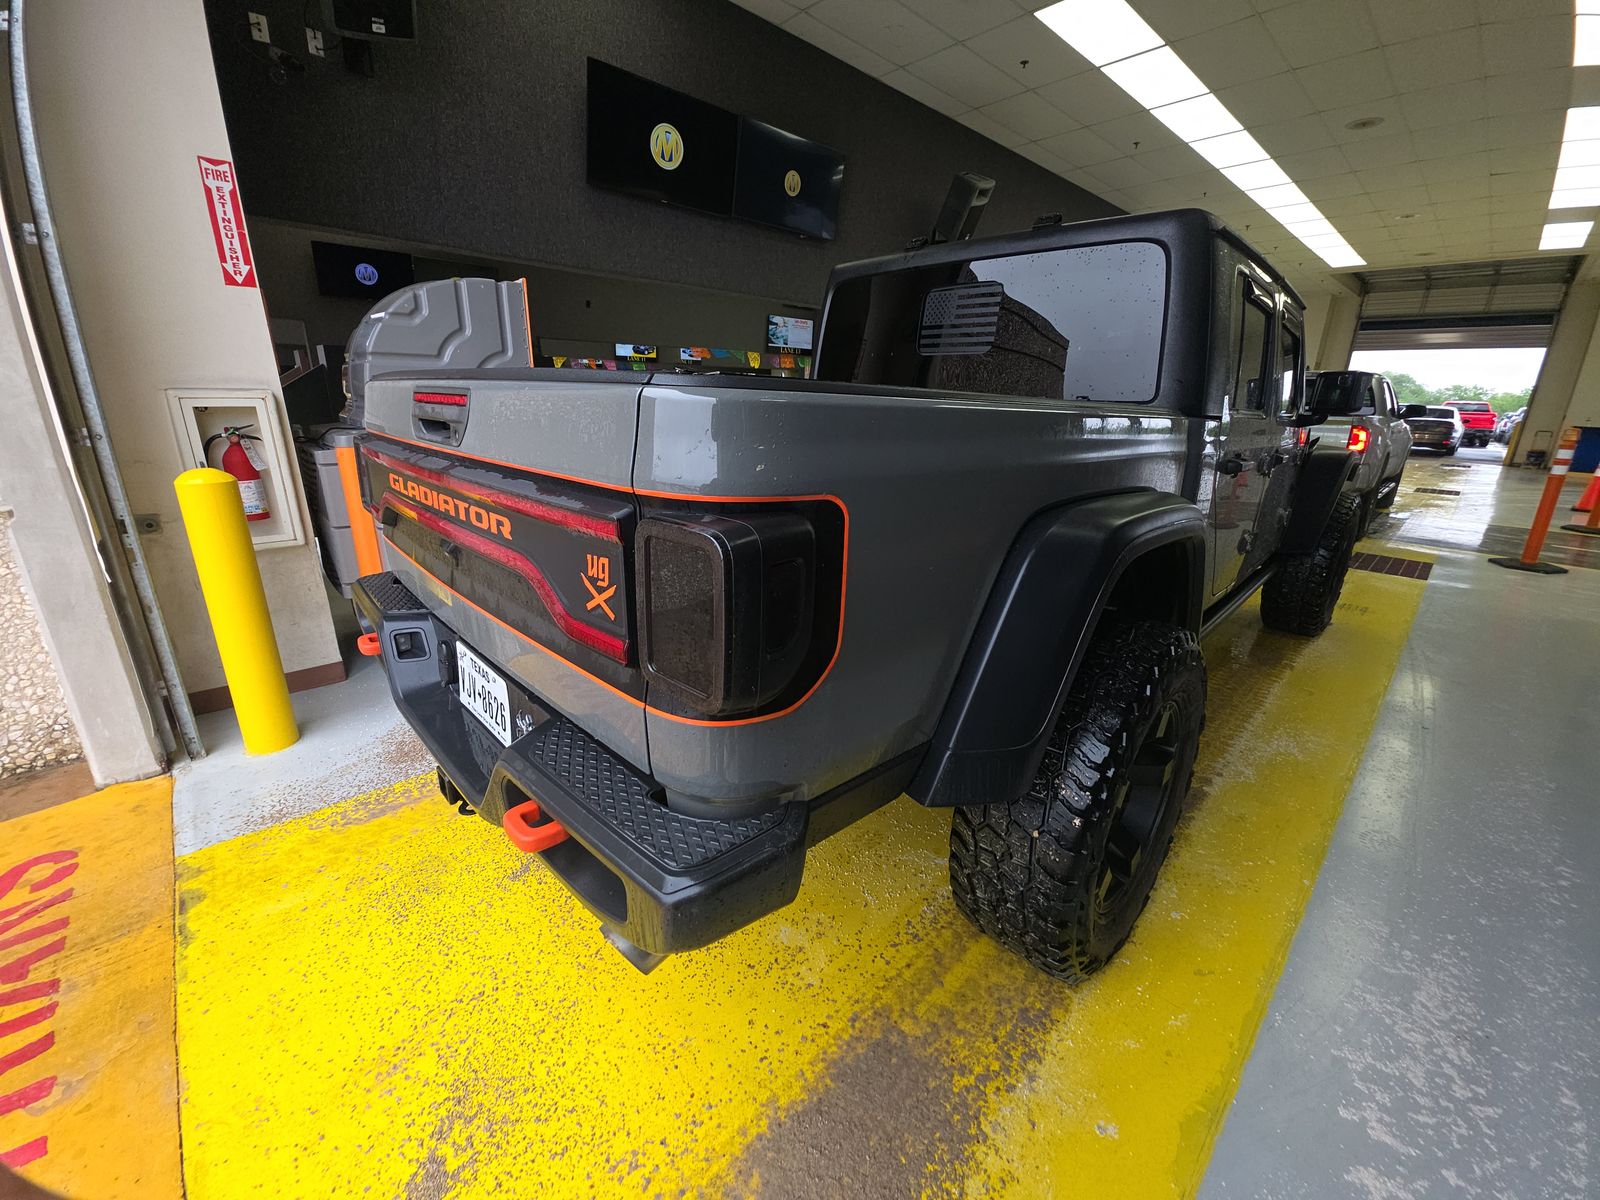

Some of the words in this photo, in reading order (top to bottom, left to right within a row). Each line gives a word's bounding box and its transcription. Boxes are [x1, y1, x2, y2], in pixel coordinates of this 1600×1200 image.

[204, 167, 230, 183] FIRE
[216, 186, 243, 277] EXTINGUISHER
[388, 473, 512, 540] GLADIATOR
[470, 657, 490, 684] TEXAS
